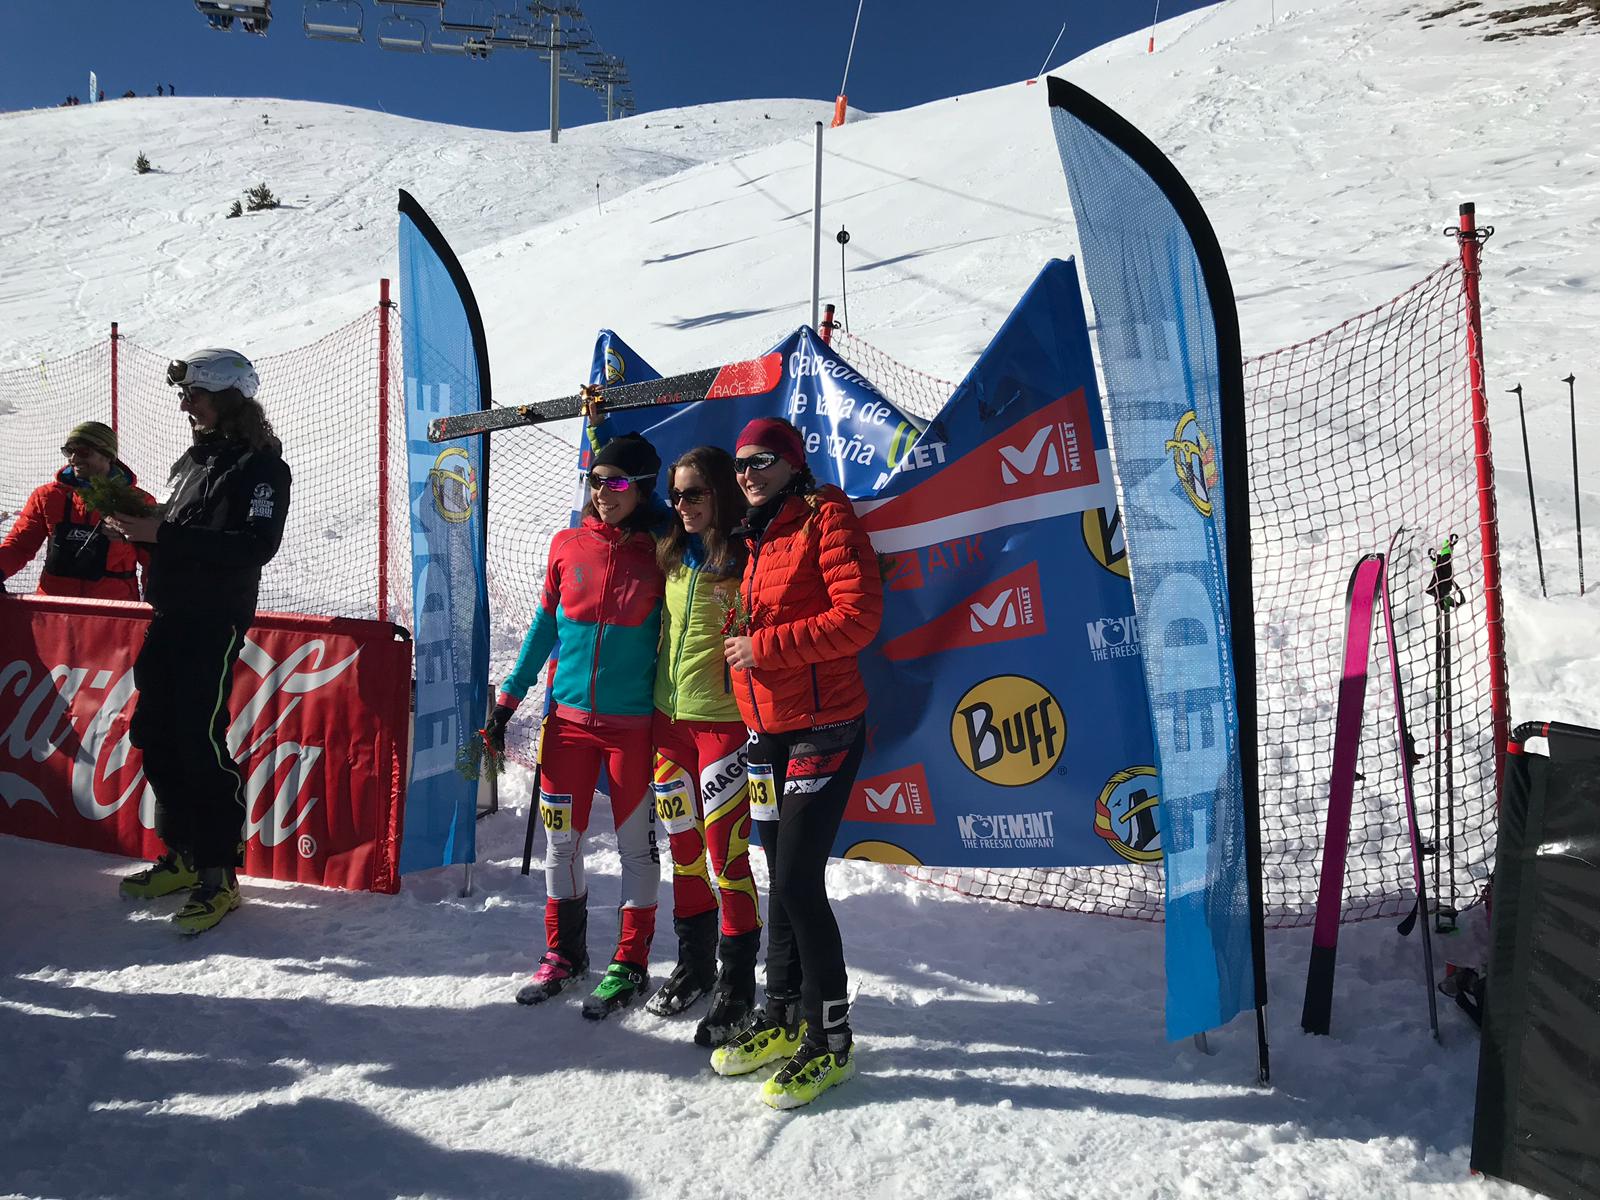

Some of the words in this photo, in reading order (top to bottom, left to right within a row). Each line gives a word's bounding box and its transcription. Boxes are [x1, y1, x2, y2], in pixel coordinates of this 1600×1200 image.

[713, 381, 746, 398] RACE
[859, 401, 891, 426] de
[1064, 422, 1081, 472] MILLET
[927, 534, 985, 573] ATK
[1021, 586, 1035, 625] MILLET
[1091, 649, 1109, 662] THE
[1110, 643, 1142, 659] FREESK
[702, 750, 748, 804] ARAGÓ
[750, 780, 768, 805] 03
[908, 782, 923, 815] MILLET
[962, 839, 979, 849] THE
[980, 839, 1013, 849] FREESKI
[1014, 838, 1055, 848] COMPANY
